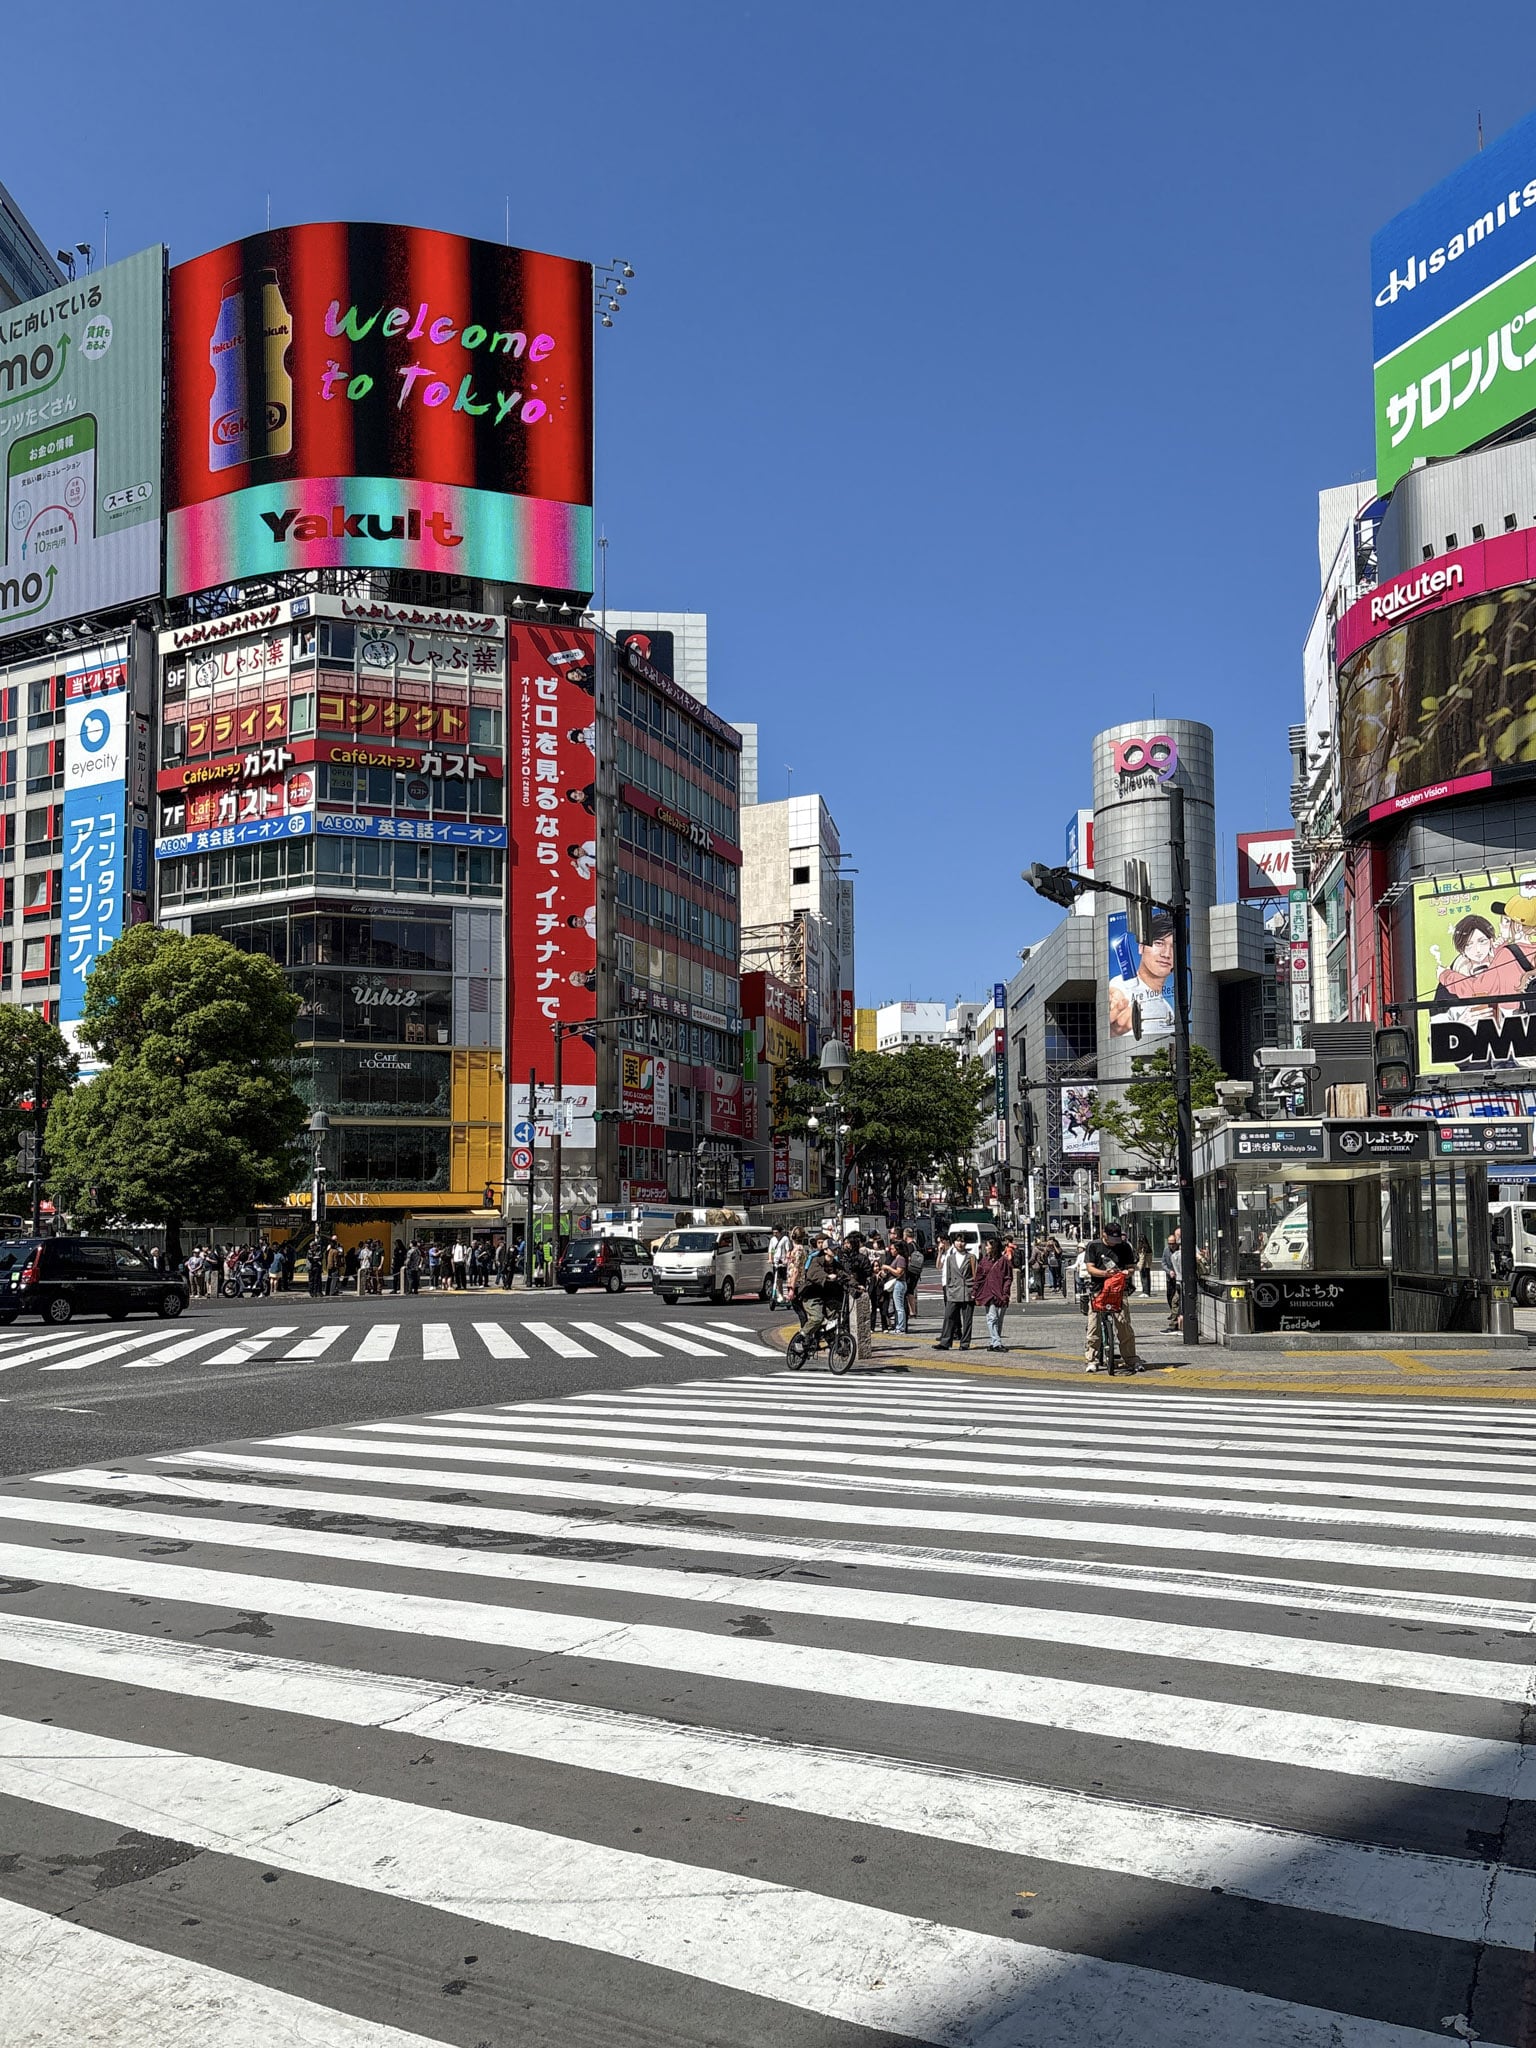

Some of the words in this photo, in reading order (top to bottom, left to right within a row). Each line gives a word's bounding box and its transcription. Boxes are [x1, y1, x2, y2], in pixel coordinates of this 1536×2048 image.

[319, 360, 374, 400] to
[395, 362, 549, 427] Tokyo
[221, 409, 278, 437] Yakt
[108, 489, 134, 509] スーモ
[260, 506, 465, 547] Yakult
[1371, 563, 1463, 623] Rakuten
[173, 605, 281, 648] しゃぶしゃぶバイキング
[342, 599, 496, 633] しゃぶしゃぶバイキング
[222, 638, 284, 676] しゃぶ葉
[407, 638, 498, 674] しゃぶ葉
[167, 669, 186, 688] 9F
[190, 702, 285, 747] プライス
[320, 697, 465, 734] コンタクト
[72, 753, 118, 778] eyecity
[243, 747, 292, 779] ガスト
[420, 752, 487, 779] ガスト
[1108, 734, 1178, 784] 109
[219, 786, 278, 825] ガスト
[1395, 792, 1423, 809] Rakuten
[1424, 785, 1448, 800] Vision
[163, 804, 185, 826] 7F
[160, 838, 189, 854] AEON
[196, 821, 284, 850] 英会話イーオン
[290, 817, 305, 831] 6F
[324, 816, 367, 832] AEON
[378, 819, 503, 844] 英会話イーオン
[690, 821, 714, 850] ガスト
[1255, 851, 1291, 875] H&M
[98, 813, 117, 953] コンタクト
[67, 816, 95, 982] アイシティ
[1131, 992, 1145, 1001] Are
[1145, 987, 1160, 999] You
[730, 1018, 742, 1035] 4F
[359, 1059, 413, 1070] L'OCCITANE
[624, 1057, 639, 1086] 薬
[716, 1097, 737, 1116] アコム
[1251, 1142, 1282, 1153] 渋谷駅
[1282, 1145, 1306, 1153] Shibuya
[1306, 1144, 1318, 1152] Sta.
[1365, 1131, 1419, 1144] しぶちか
[1283, 1284, 1344, 1299] しぶちか
[1289, 1300, 1335, 1308] SHIBUCHIKA
